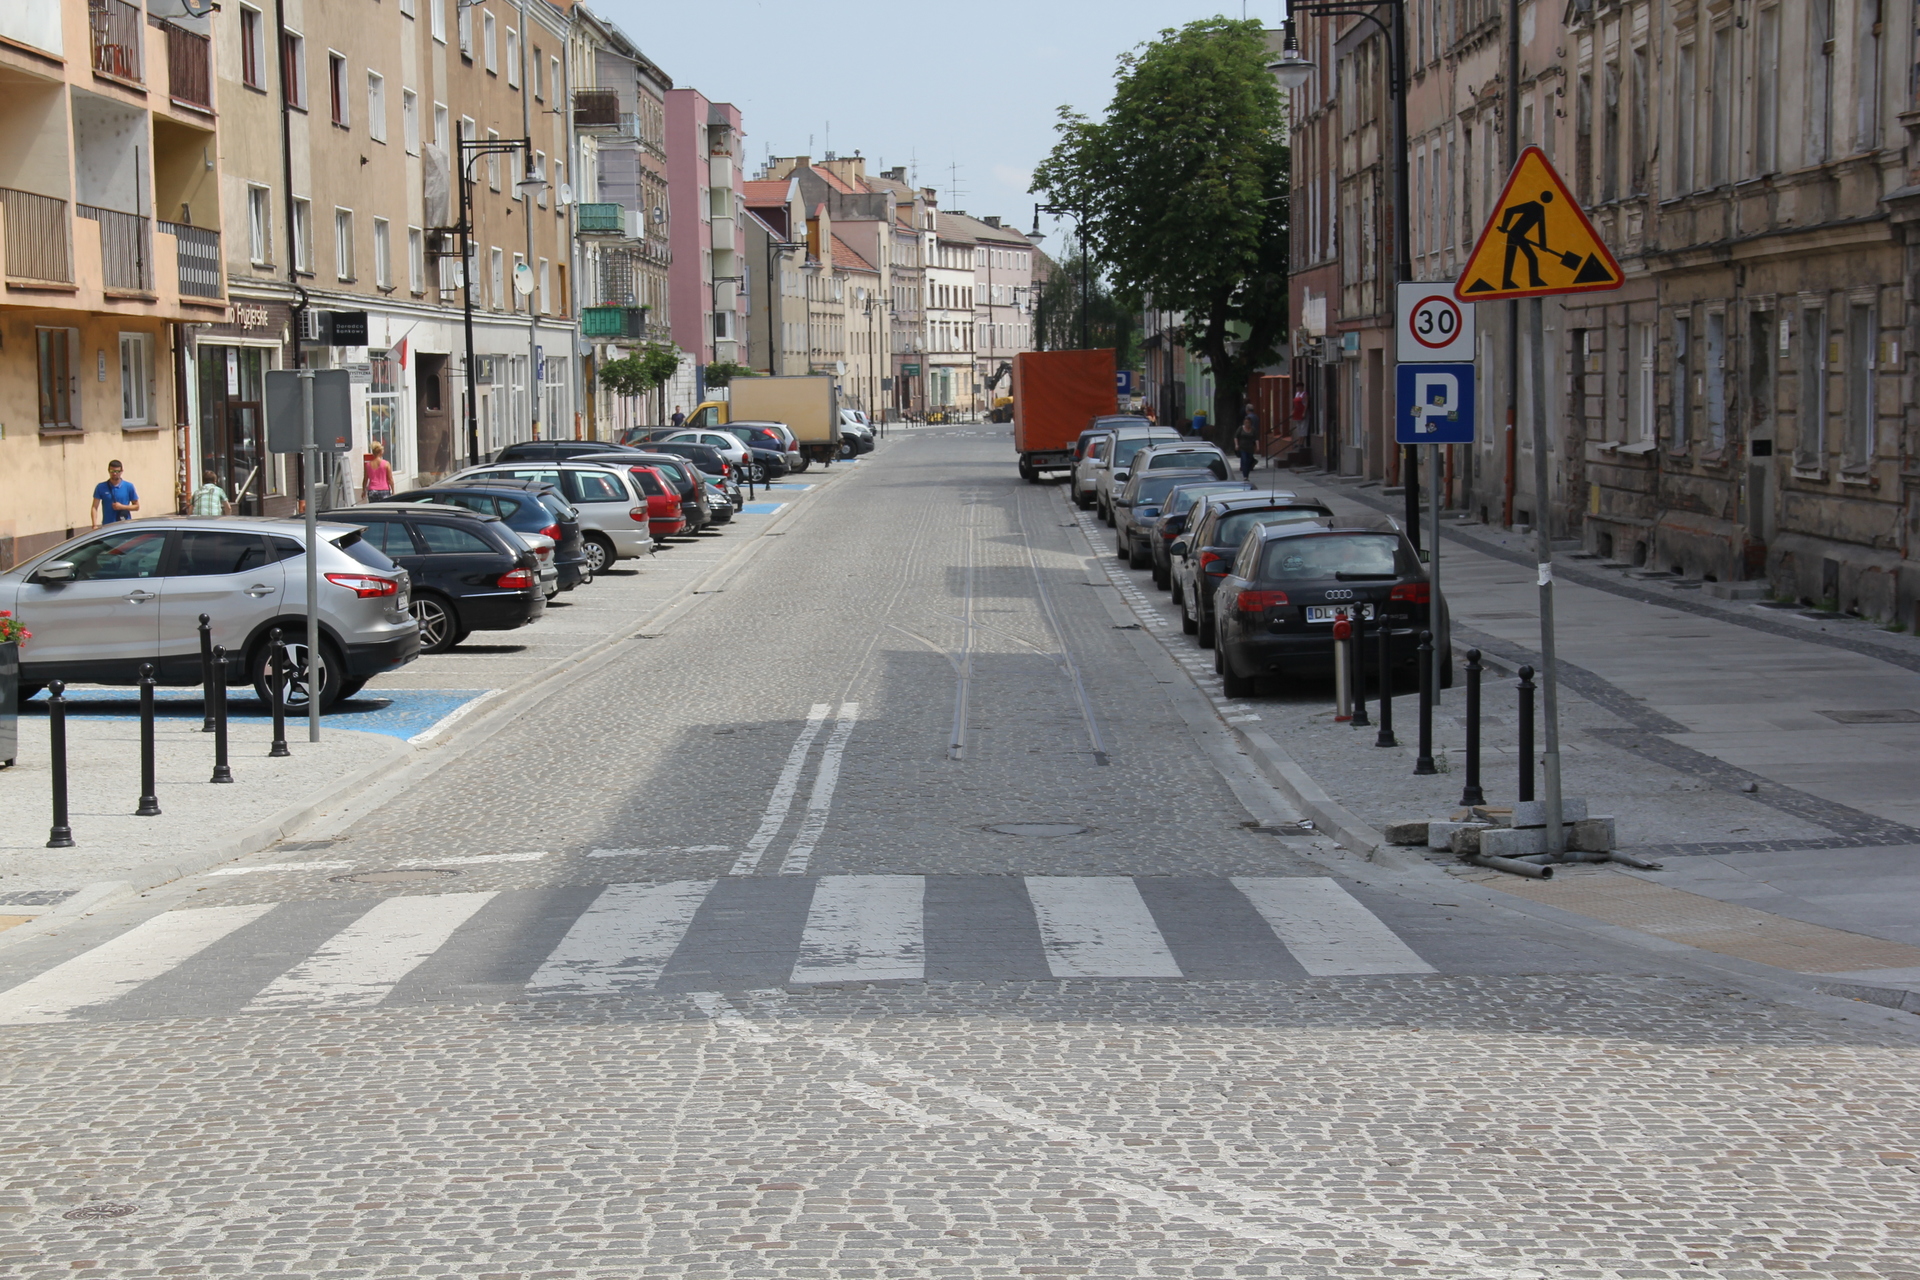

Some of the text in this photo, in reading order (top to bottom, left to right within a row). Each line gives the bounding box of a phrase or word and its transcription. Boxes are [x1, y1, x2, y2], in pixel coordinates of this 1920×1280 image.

[1418, 310, 1454, 334] 30
[1415, 373, 1459, 433] P
[1315, 605, 1370, 619] DL 9135
